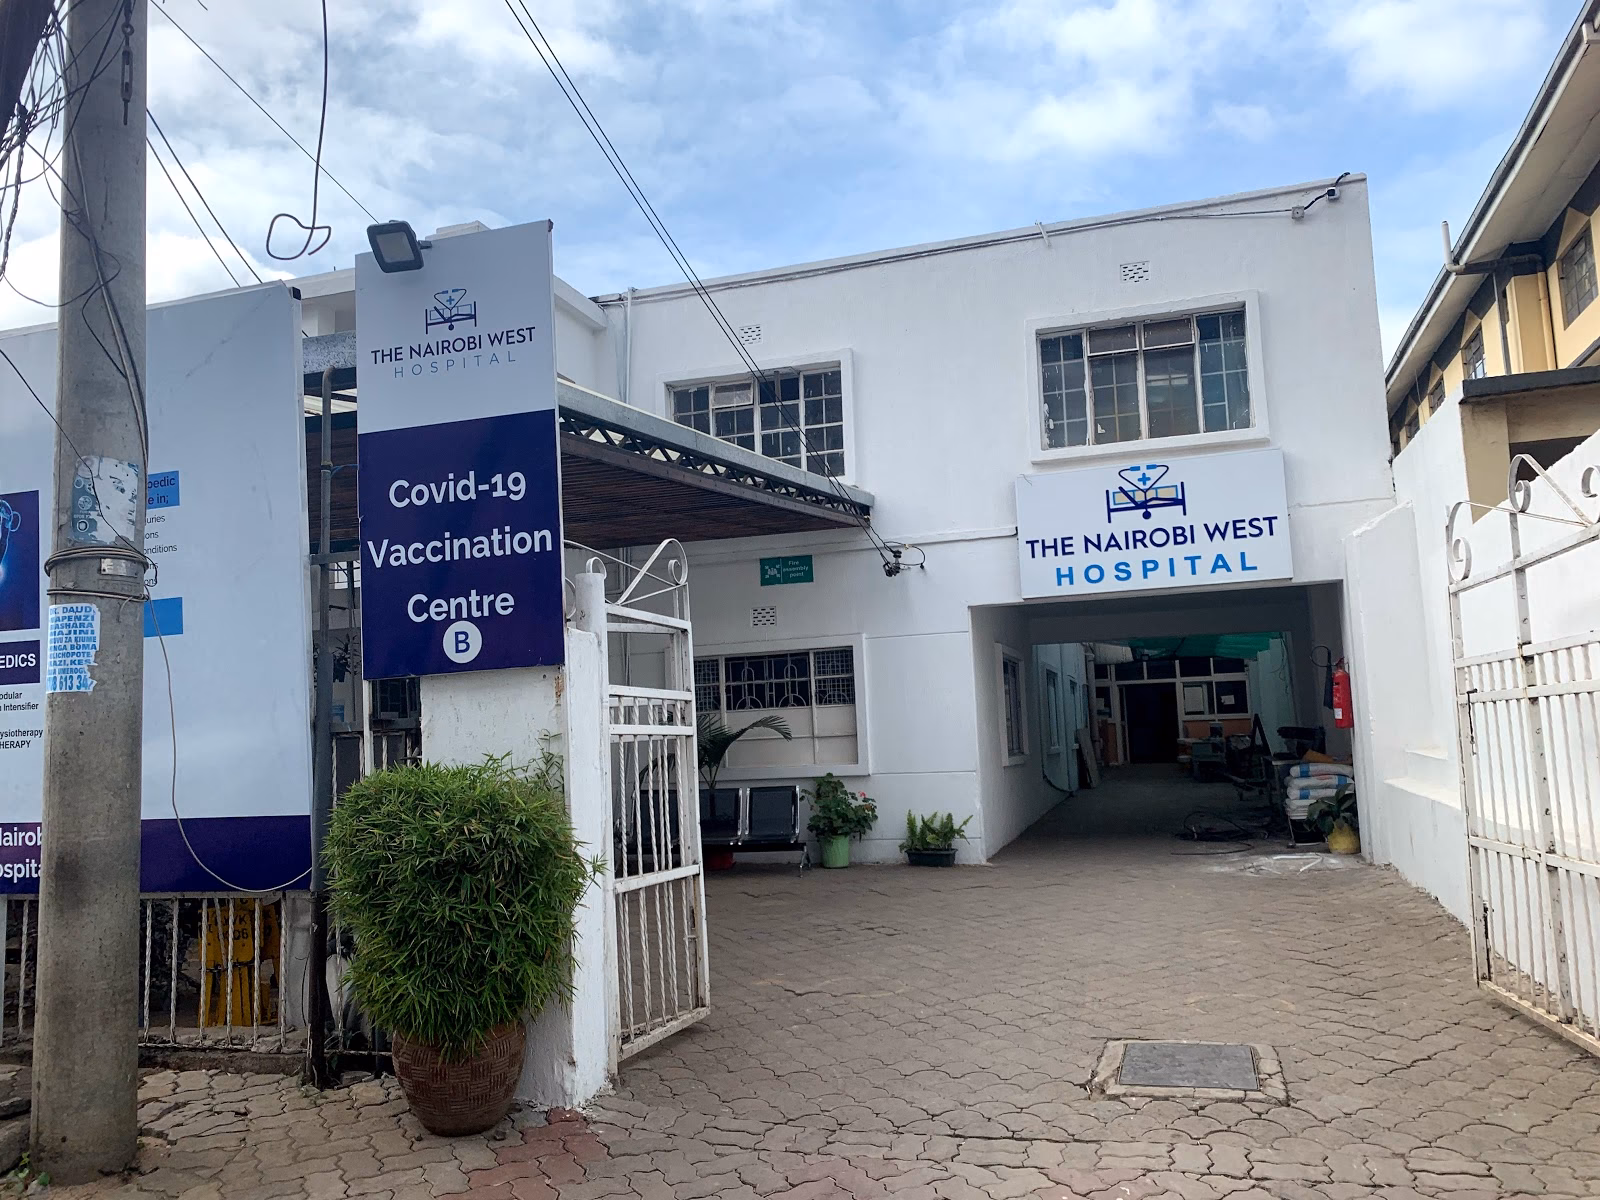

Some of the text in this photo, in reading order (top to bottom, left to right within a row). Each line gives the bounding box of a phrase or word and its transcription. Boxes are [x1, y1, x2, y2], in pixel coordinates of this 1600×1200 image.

[371, 326, 536, 364] THE NAIROBI WEST
[394, 351, 516, 378] HOSPITAL
[389, 470, 526, 508] Covid-19
[147, 515, 166, 524] uries
[1026, 515, 1278, 559] THE NAIROBI WEST
[367, 525, 552, 569] Vaccination
[1056, 551, 1258, 586] HOSPITAL
[407, 589, 515, 623] Centre
[454, 631, 470, 653] B
